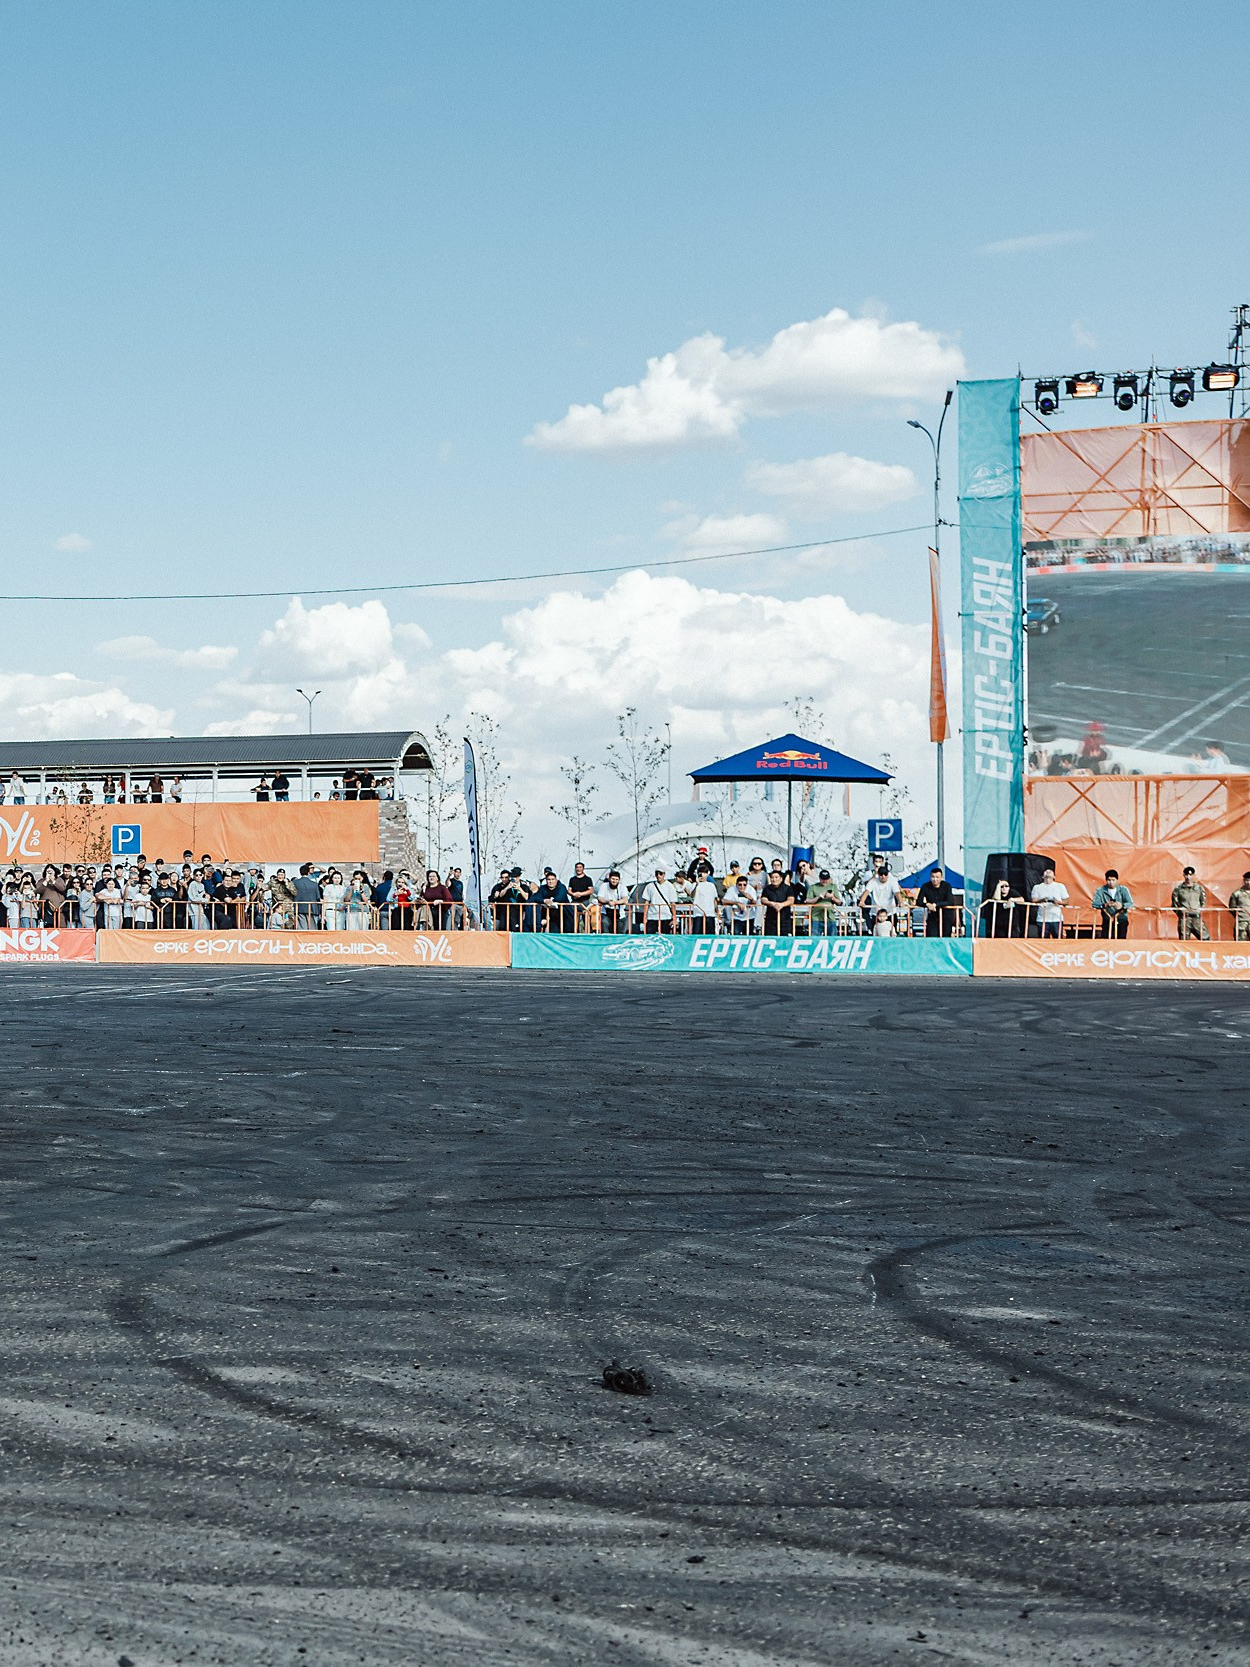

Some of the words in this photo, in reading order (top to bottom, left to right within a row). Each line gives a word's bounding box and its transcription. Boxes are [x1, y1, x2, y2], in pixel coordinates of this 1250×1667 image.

[756, 760, 791, 769] Red
[794, 761, 828, 770] Bull
[118, 828, 134, 852] P
[876, 823, 894, 847] P
[0, 930, 60, 952] NGK
[0, 953, 29, 961] SPARK
[30, 953, 60, 961] PLUGS
